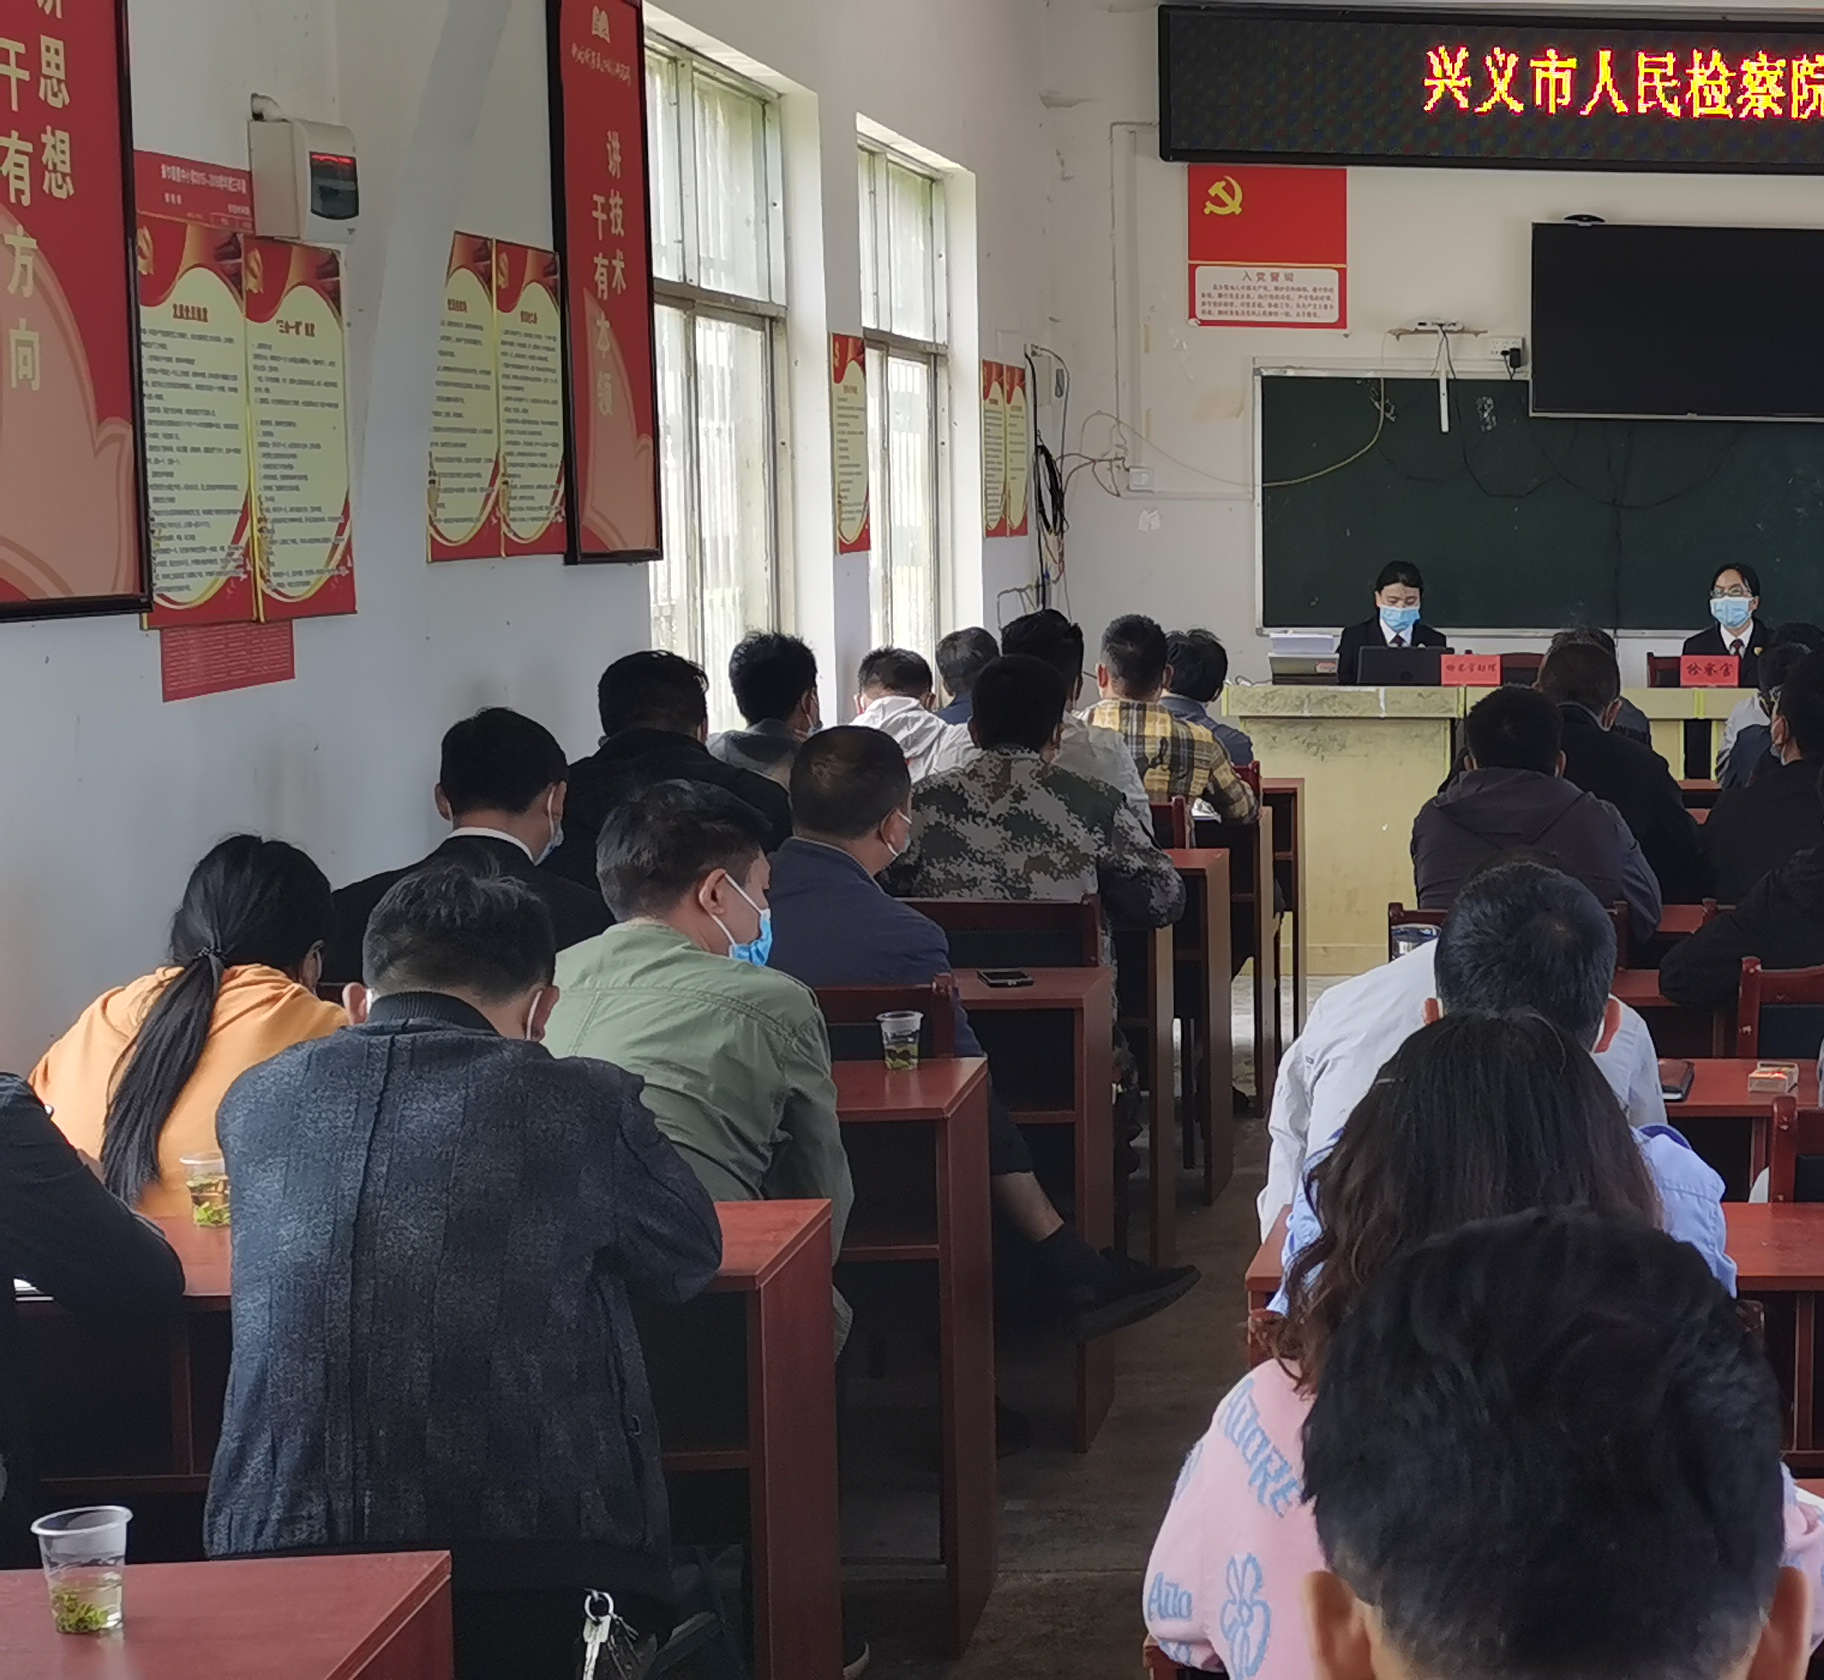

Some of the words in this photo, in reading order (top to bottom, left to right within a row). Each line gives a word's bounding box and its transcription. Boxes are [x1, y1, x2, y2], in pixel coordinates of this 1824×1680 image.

[36, 0, 75, 200] 思想
[0, 37, 41, 393] 干有方向
[591, 192, 614, 416] 干有本领
[606, 130, 627, 296] 讲技术
